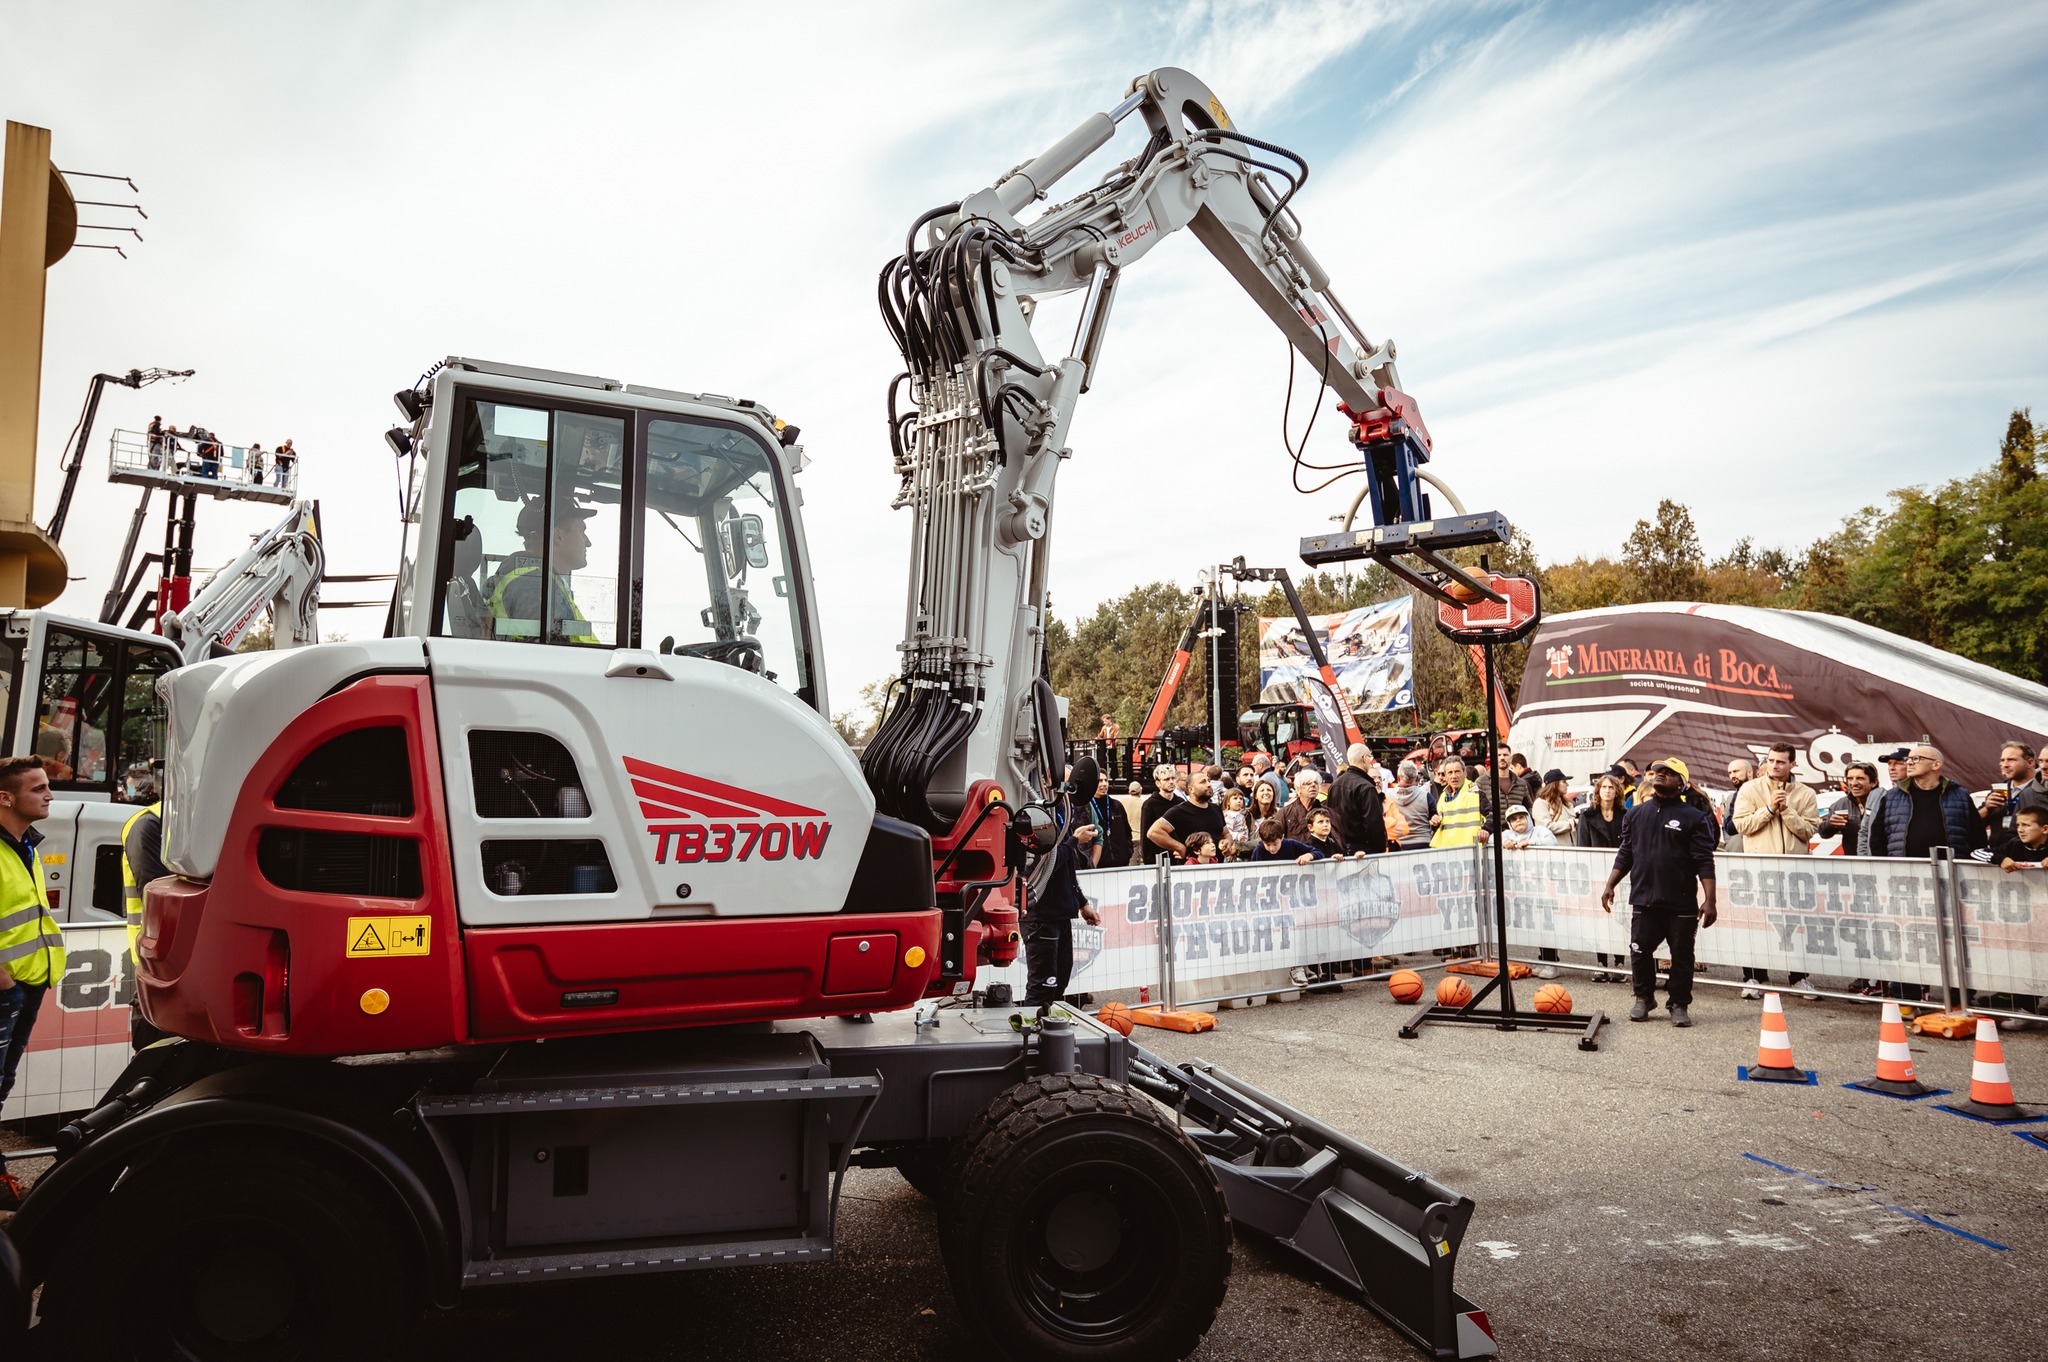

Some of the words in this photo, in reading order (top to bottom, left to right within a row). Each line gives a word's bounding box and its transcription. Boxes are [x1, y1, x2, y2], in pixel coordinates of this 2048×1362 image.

[1116, 219, 1155, 249] KEUCHI
[220, 591, 267, 647] AKEUCHI
[1577, 643, 1689, 675] MINERARIA
[1693, 653, 1713, 679] di
[1719, 648, 1781, 689] BOCA
[1655, 682, 1701, 695] unipersonale
[1328, 683, 1356, 730] MANITOU
[646, 821, 832, 865] TB370W
